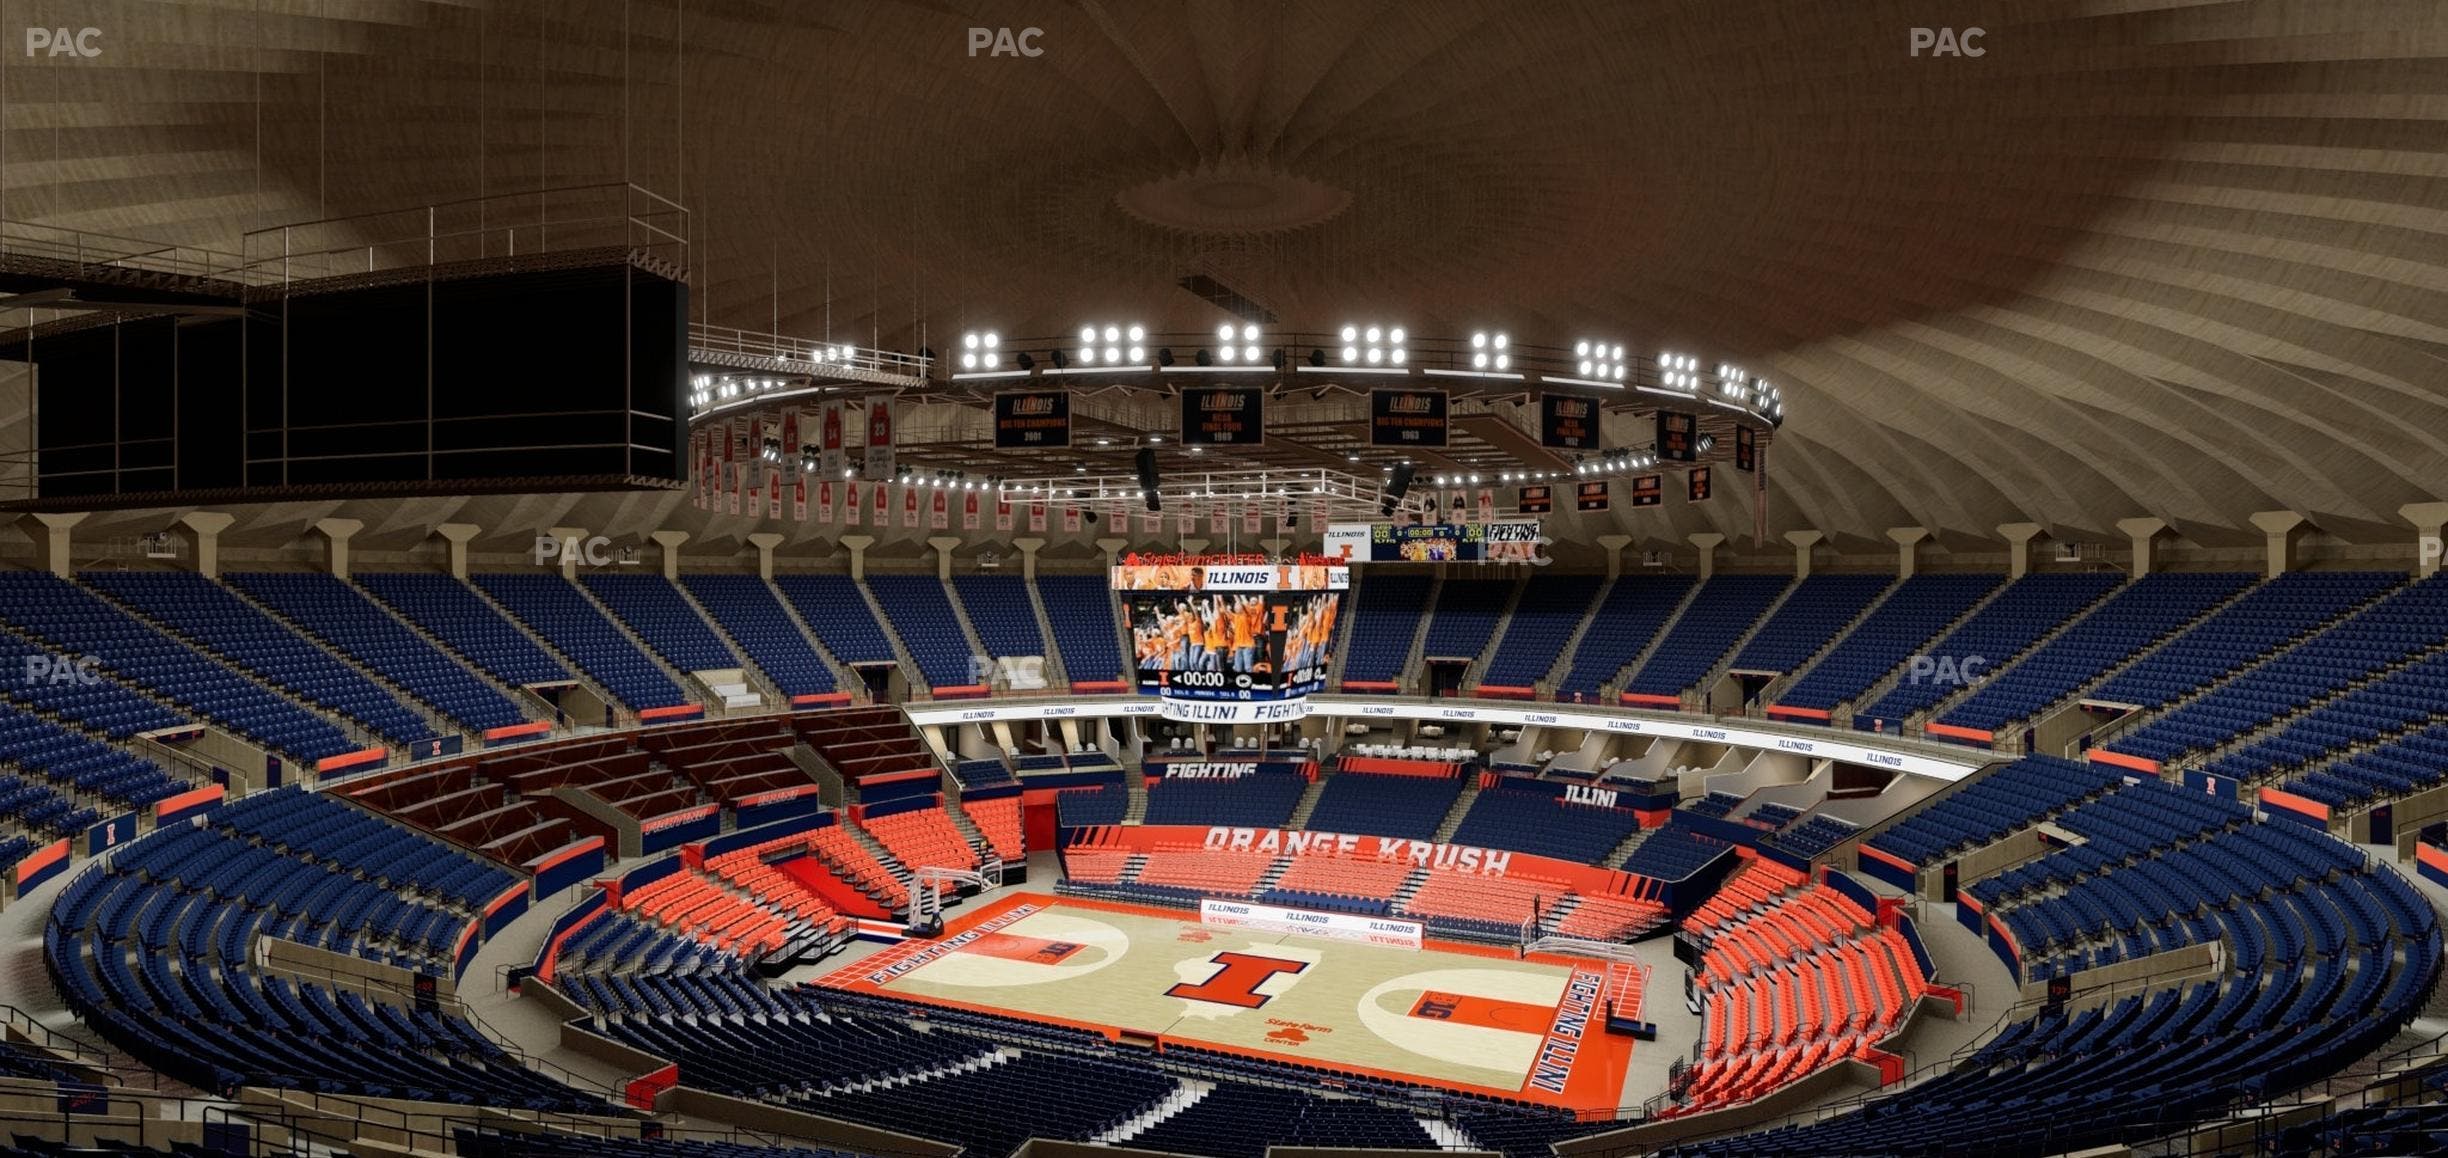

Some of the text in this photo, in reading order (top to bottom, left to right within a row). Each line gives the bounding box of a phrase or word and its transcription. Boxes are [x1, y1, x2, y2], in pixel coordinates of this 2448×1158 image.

[1012, 396, 1054, 415] ILLINOIS
[1201, 393, 1245, 411] ILLINOIS
[1389, 396, 1431, 413] ILLINOIS
[1208, 572, 1269, 584] ILLINOIS
[1183, 671, 1224, 687] 00:00
[963, 711, 996, 720] ILLINOIS
[1043, 707, 1076, 716] ILLINOIS
[1123, 705, 1155, 713] ILLINOIS
[1192, 704, 1238, 719] ILLINI
[1362, 706, 1395, 715] ILLINOIS
[1442, 709, 1476, 718] ILLINOIS
[1524, 713, 1557, 724] ILLINOIS
[1607, 721, 1641, 731] ILLINOIS
[1692, 729, 1727, 740] ILLINOIS
[1778, 740, 1813, 752] ILLINOIS
[1866, 752, 1902, 767] ILLINOIS
[1165, 762, 1257, 779] FIGHTING
[1565, 784, 1618, 808] ILLINI
[1204, 826, 1511, 876] ORANGE KRUSH
[1208, 903, 1249, 915] ILLINOIS
[1286, 911, 1329, 924] ILLINOIS
[1369, 921, 1415, 934] ILLINOIS
[863, 929, 980, 985] FIGHTING
[1529, 970, 1602, 1095] FIGHTING ILLINI
[1263, 1037, 1300, 1047] CENTER
